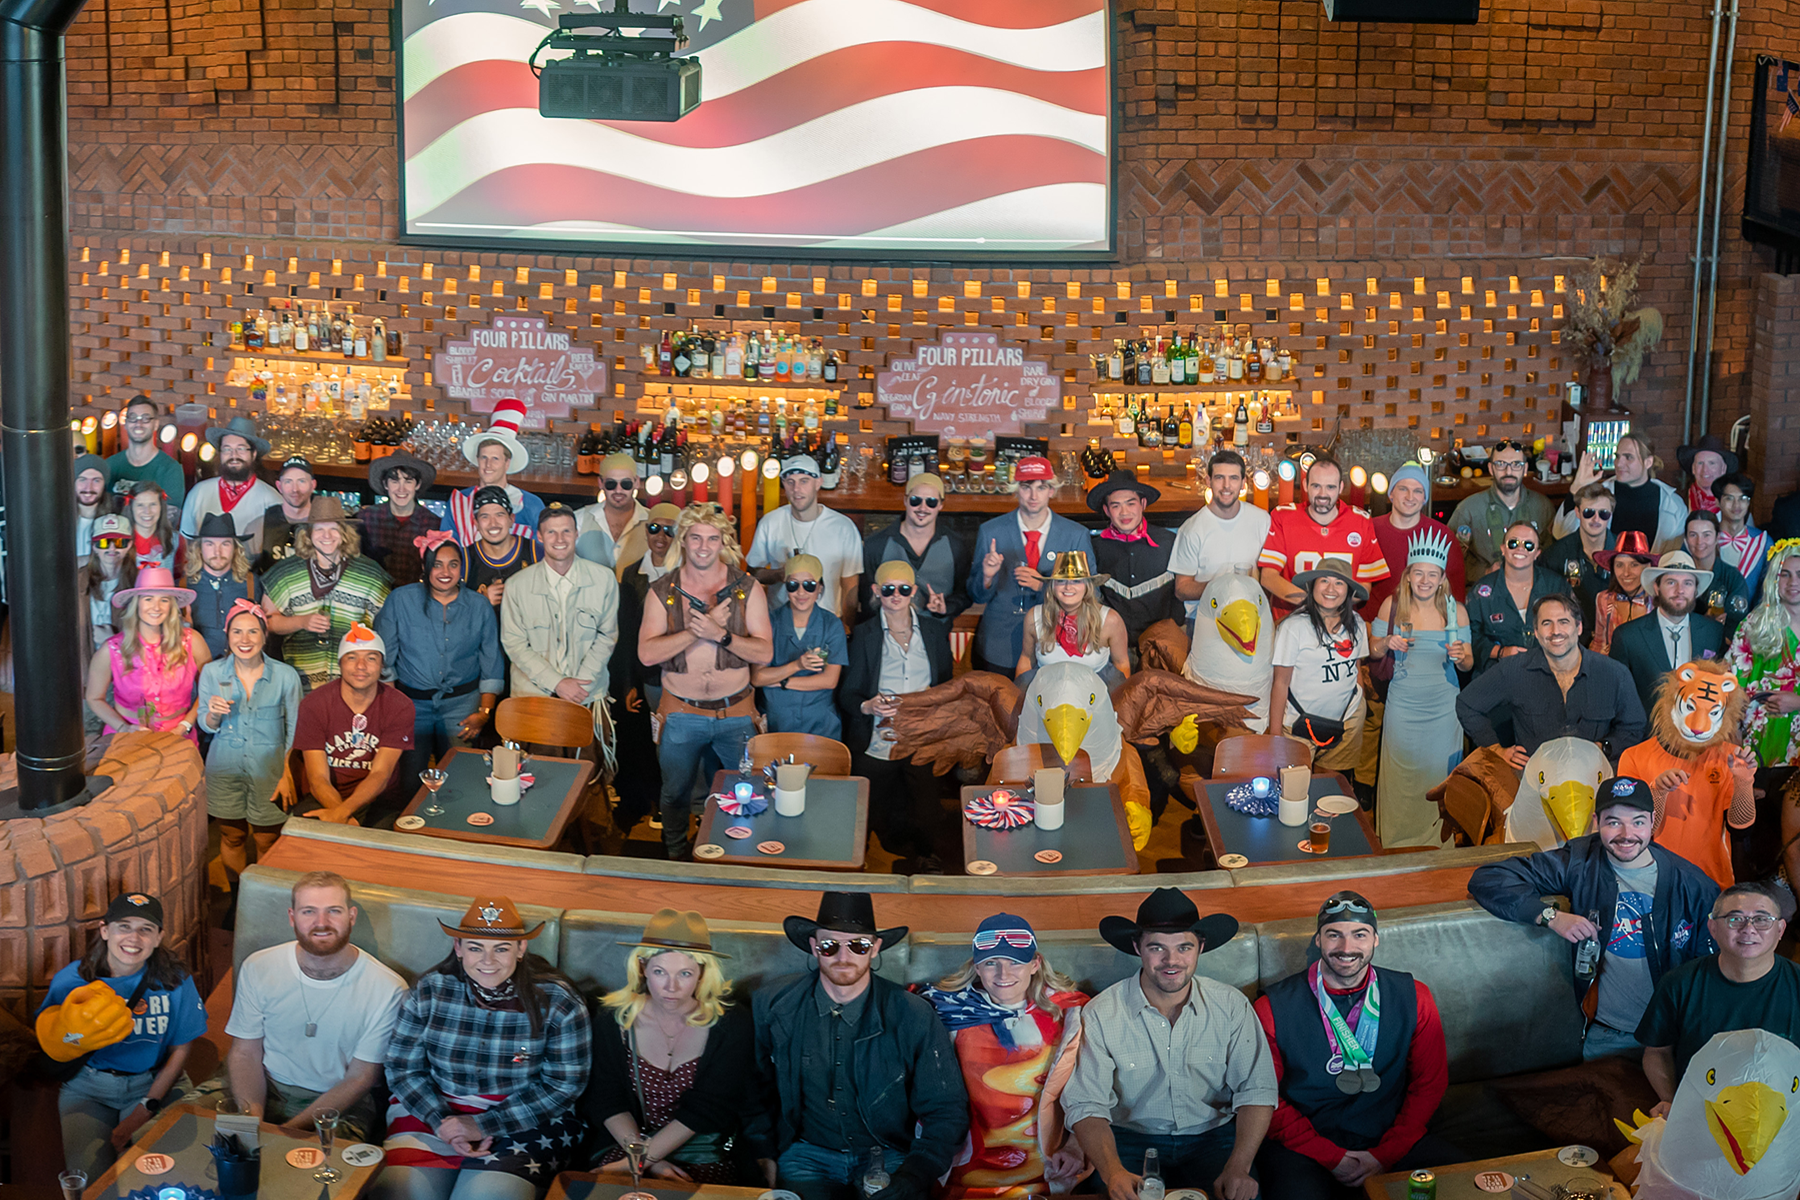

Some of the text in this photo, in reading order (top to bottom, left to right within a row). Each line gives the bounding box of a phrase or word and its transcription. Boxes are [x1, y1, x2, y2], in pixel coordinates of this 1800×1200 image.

[473, 331, 569, 351] FOUR PILLARS
[918, 346, 1023, 366] FOUR PILLARS
[466, 354, 577, 391] Cocktails
[892, 361, 917, 372] OLIVE
[1020, 377, 1056, 387] DRY GIN
[541, 391, 557, 403] GIN
[1321, 659, 1357, 683] NY
[327, 756, 352, 768] RACK
[1614, 784, 1634, 792] NASA
[1617, 917, 1642, 933] AS
[1332, 1016, 1360, 1051] FINISHER
